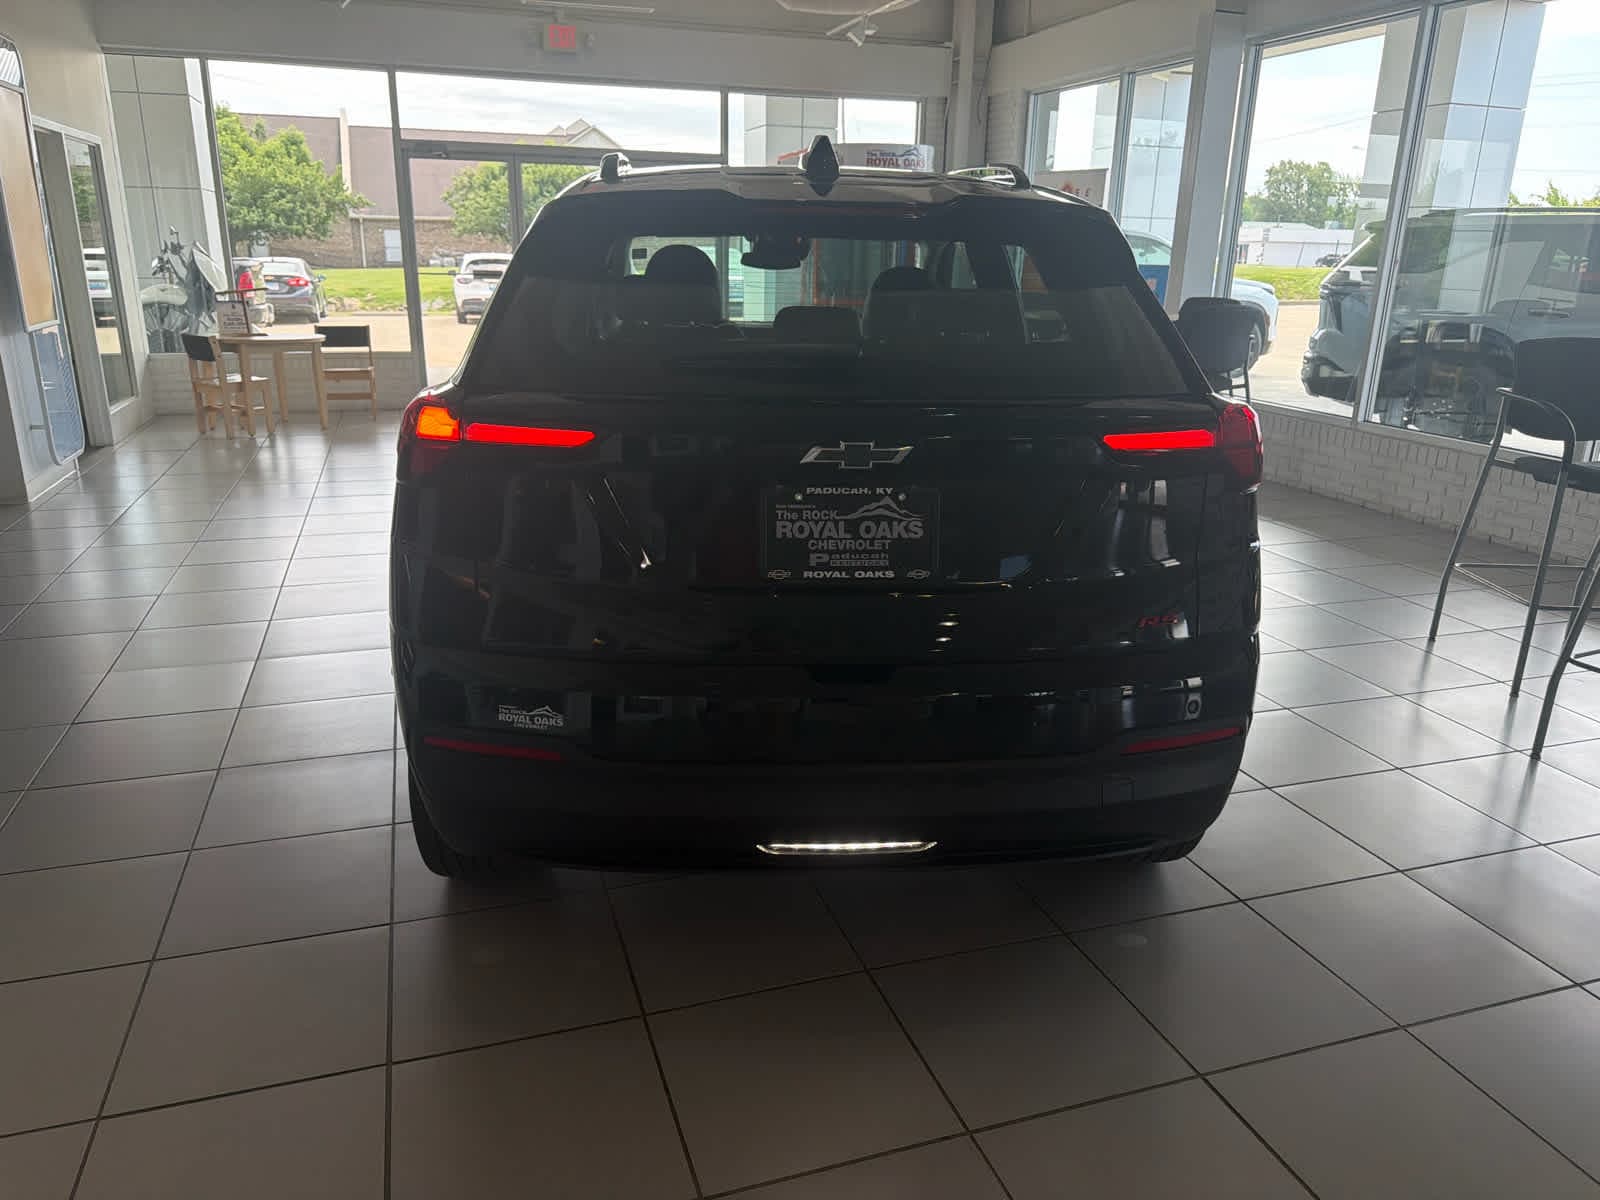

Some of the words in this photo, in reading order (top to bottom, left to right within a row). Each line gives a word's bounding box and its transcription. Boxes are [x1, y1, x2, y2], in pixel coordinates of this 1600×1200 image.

[864, 157, 900, 168] ROYAL
[903, 158, 926, 168] OAKS
[876, 487, 894, 495] KY
[776, 510, 799, 520] The
[802, 510, 839, 520] ROCK
[776, 520, 853, 538] ROYAL
[859, 520, 924, 538] OAKS
[808, 539, 891, 551] CHEVROLET
[498, 712, 533, 725] ROYAL
[534, 716, 564, 727] OAKS
